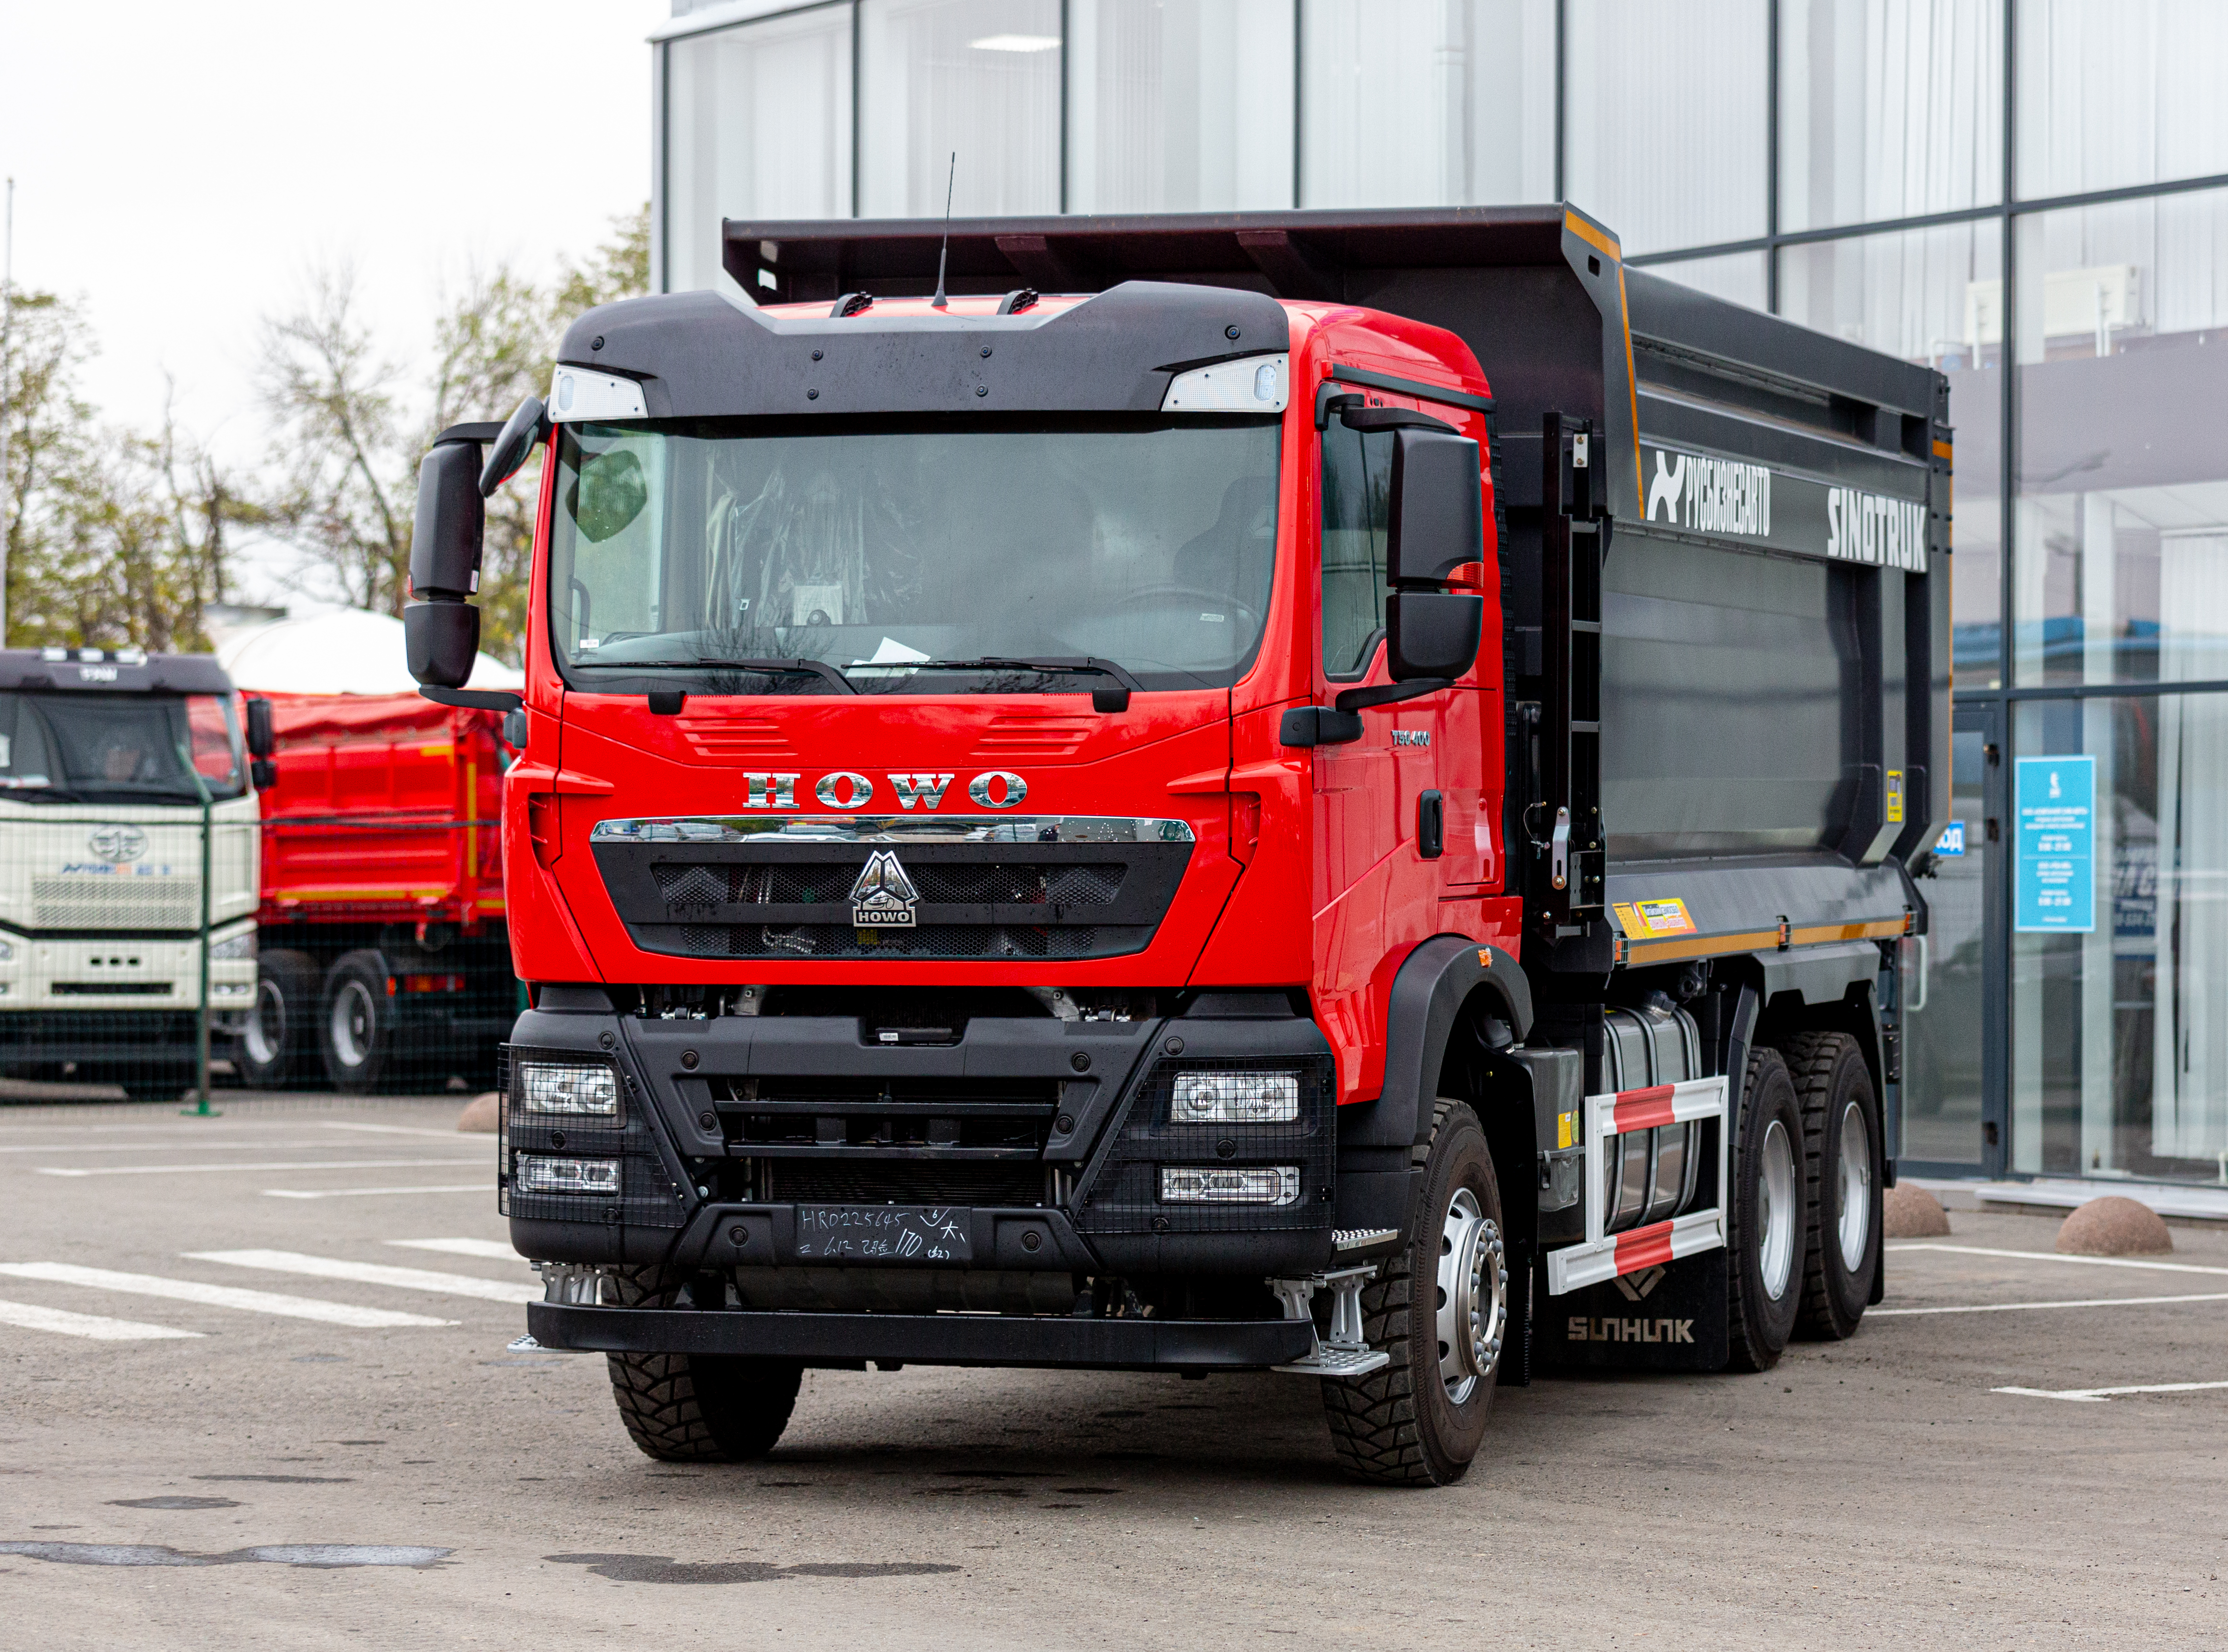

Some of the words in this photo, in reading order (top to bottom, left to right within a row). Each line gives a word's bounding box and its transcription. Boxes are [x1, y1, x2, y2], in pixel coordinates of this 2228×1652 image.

[1685, 455, 1771, 537] РУСБИЗНЕСАВТО
[1827, 487, 1927, 573] SINOTRUK
[742, 771, 1027, 809] HOWO
[1936, 827, 1963, 852] ОД
[858, 912, 910, 923] HOWO
[802, 1211, 910, 1231] HRD225645
[1567, 1317, 1695, 1343] SUNHUNK
